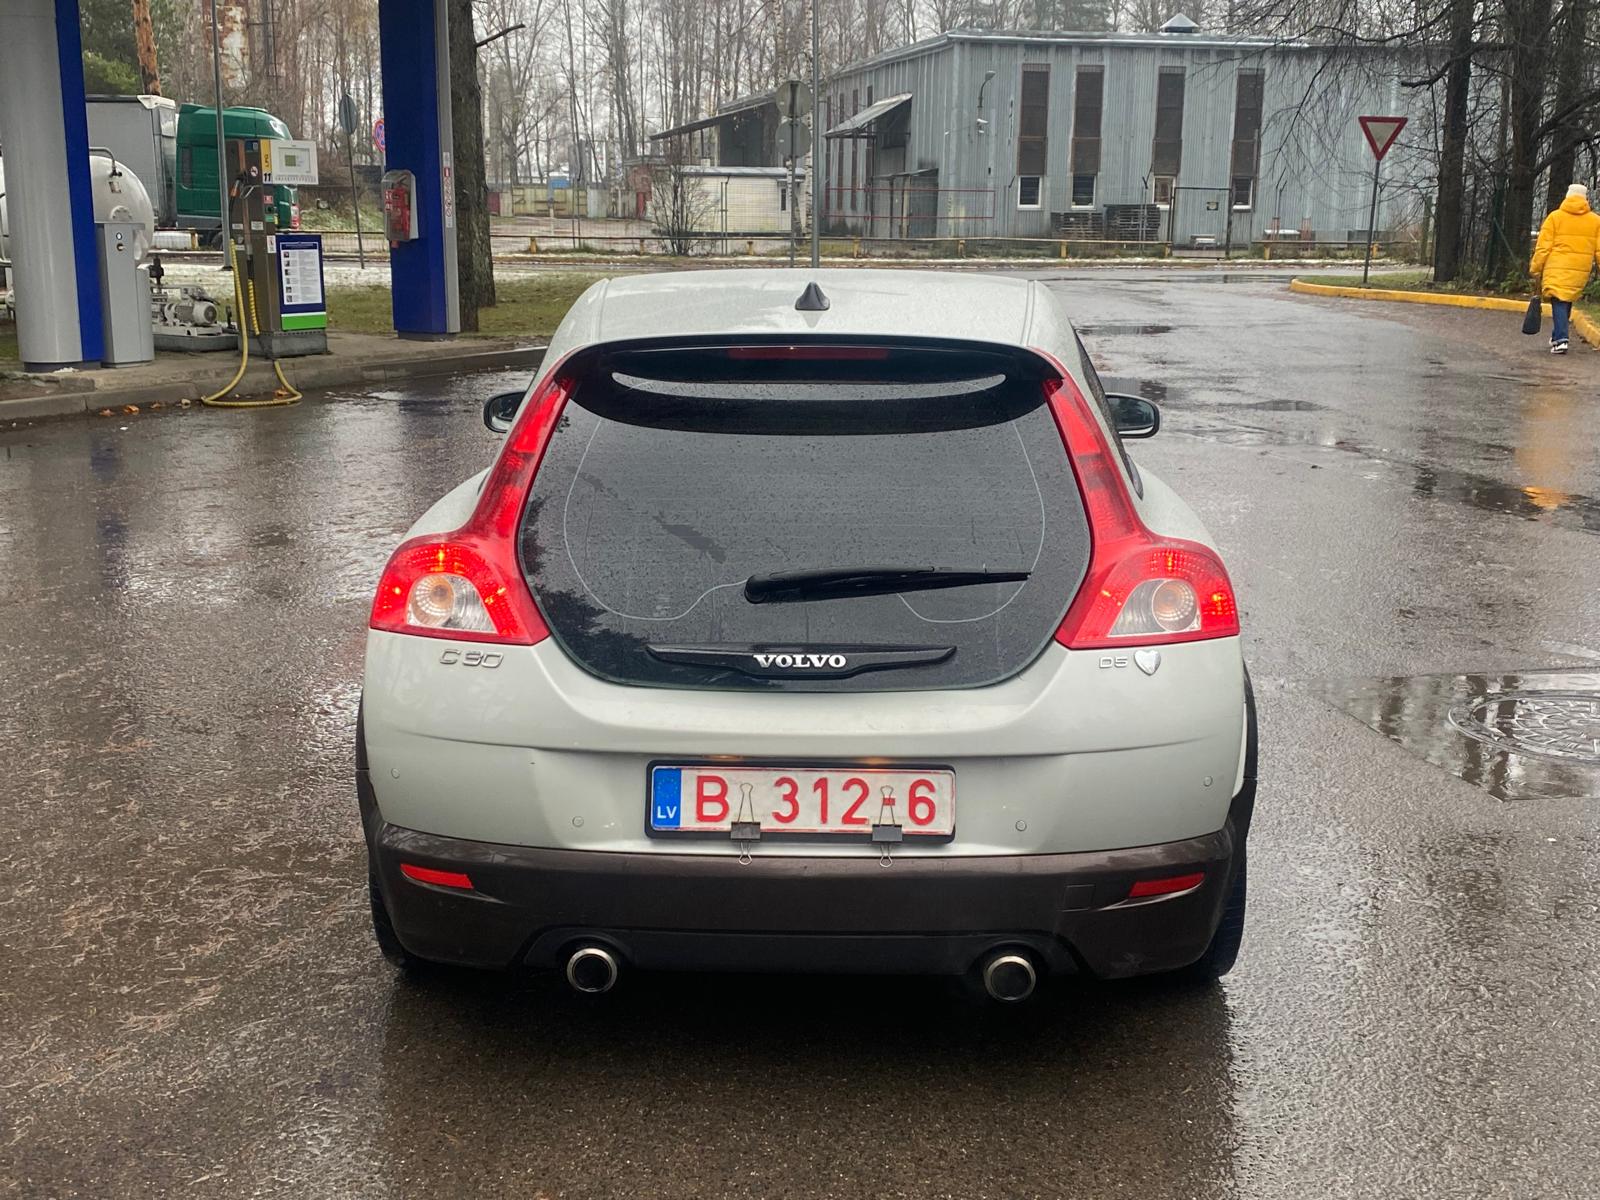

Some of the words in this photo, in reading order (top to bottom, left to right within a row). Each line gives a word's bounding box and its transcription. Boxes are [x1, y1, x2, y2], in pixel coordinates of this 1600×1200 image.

[264, 172, 271, 182] 11
[752, 654, 847, 668] VOLVO
[1099, 656, 1128, 669] D5
[695, 775, 730, 823] B
[657, 806, 677, 819] LV
